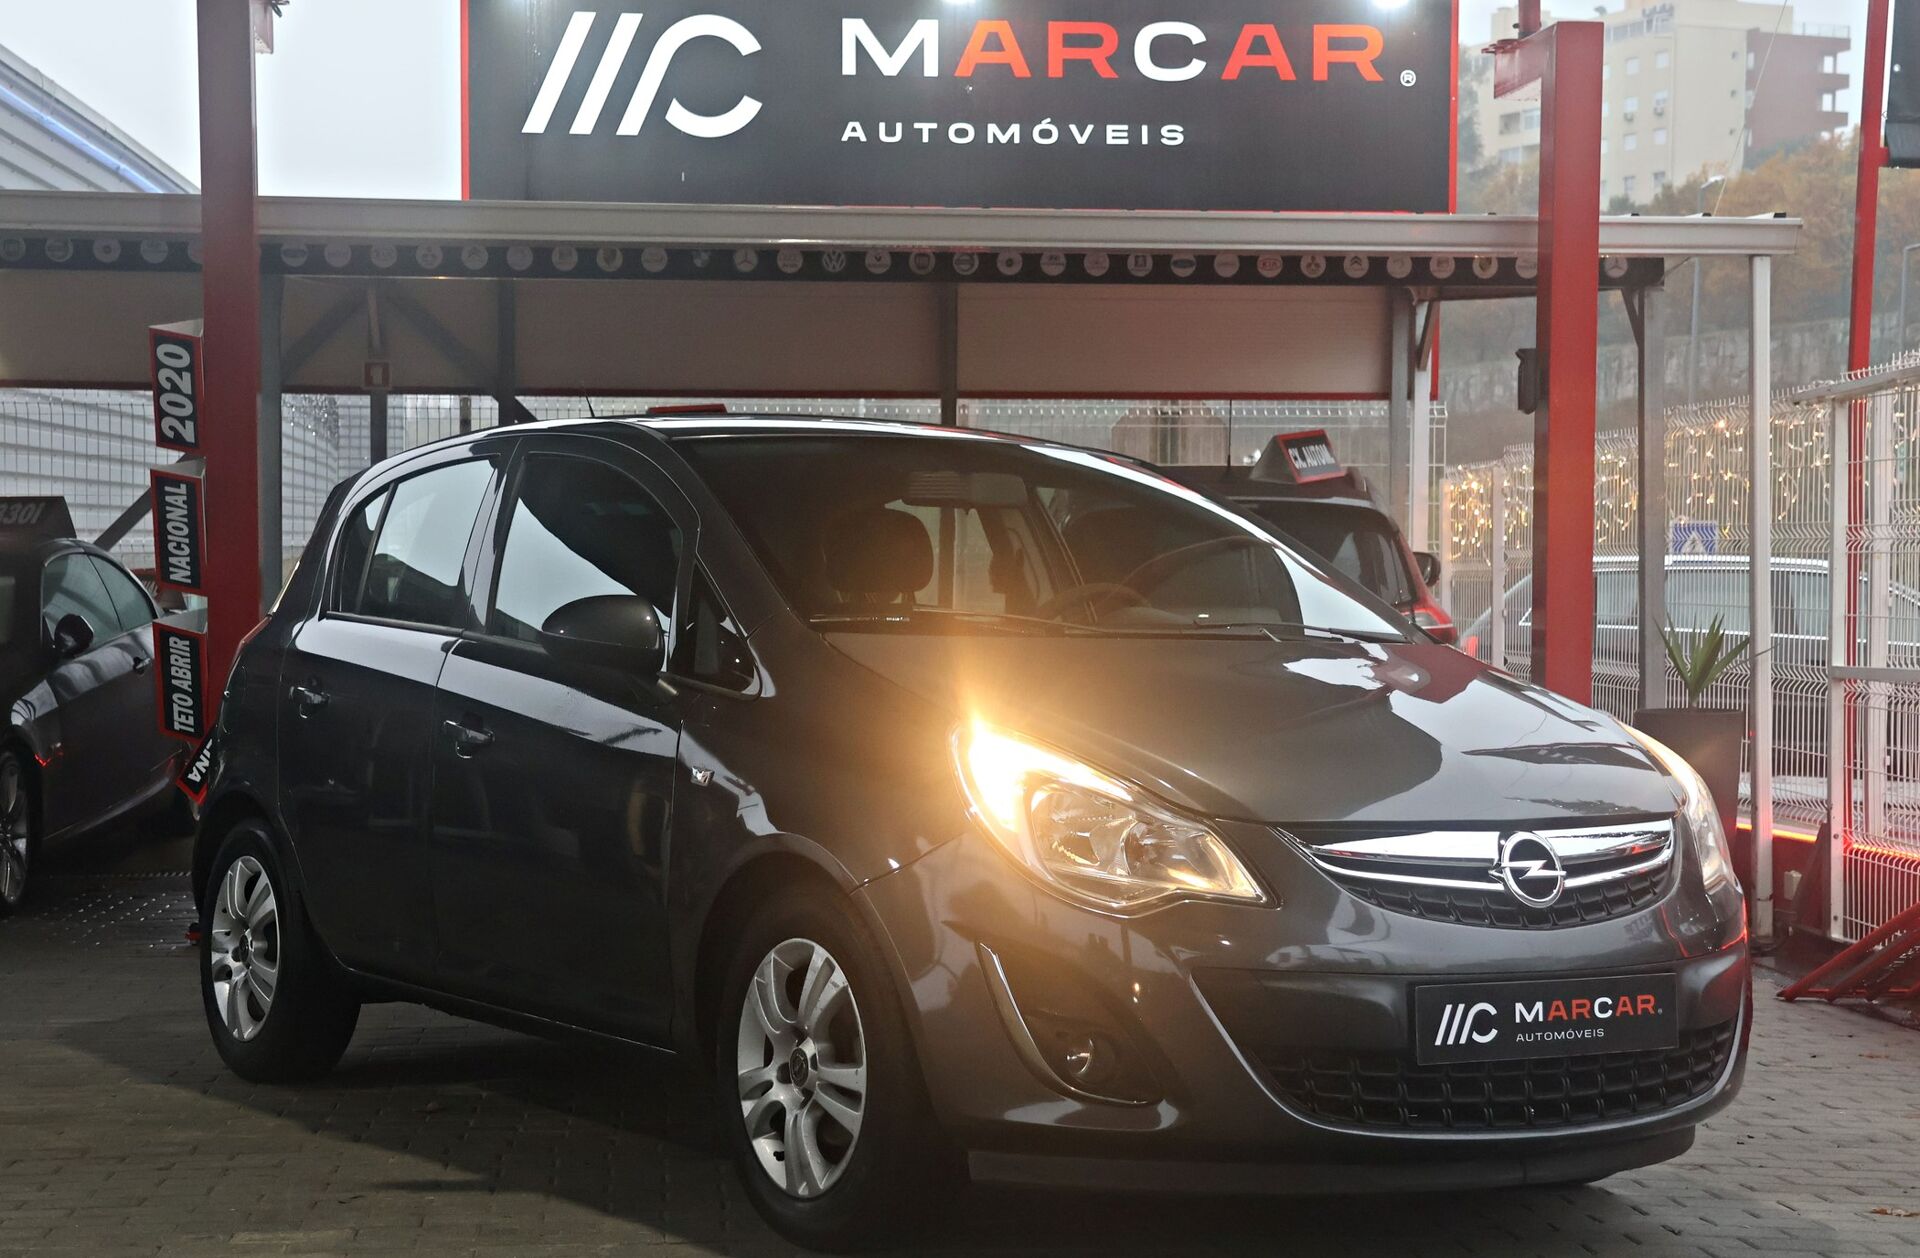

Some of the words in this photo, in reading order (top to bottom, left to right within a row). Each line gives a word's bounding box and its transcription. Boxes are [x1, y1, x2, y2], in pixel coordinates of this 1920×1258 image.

[841, 118, 1185, 145] AUTOMÓVEIS
[156, 343, 195, 443] 2020
[164, 483, 192, 584] NACIONAL
[168, 636, 193, 693] ABRIR
[172, 692, 195, 733] TETO
[1515, 1028, 1606, 1042] AUTOMÓVEIS
